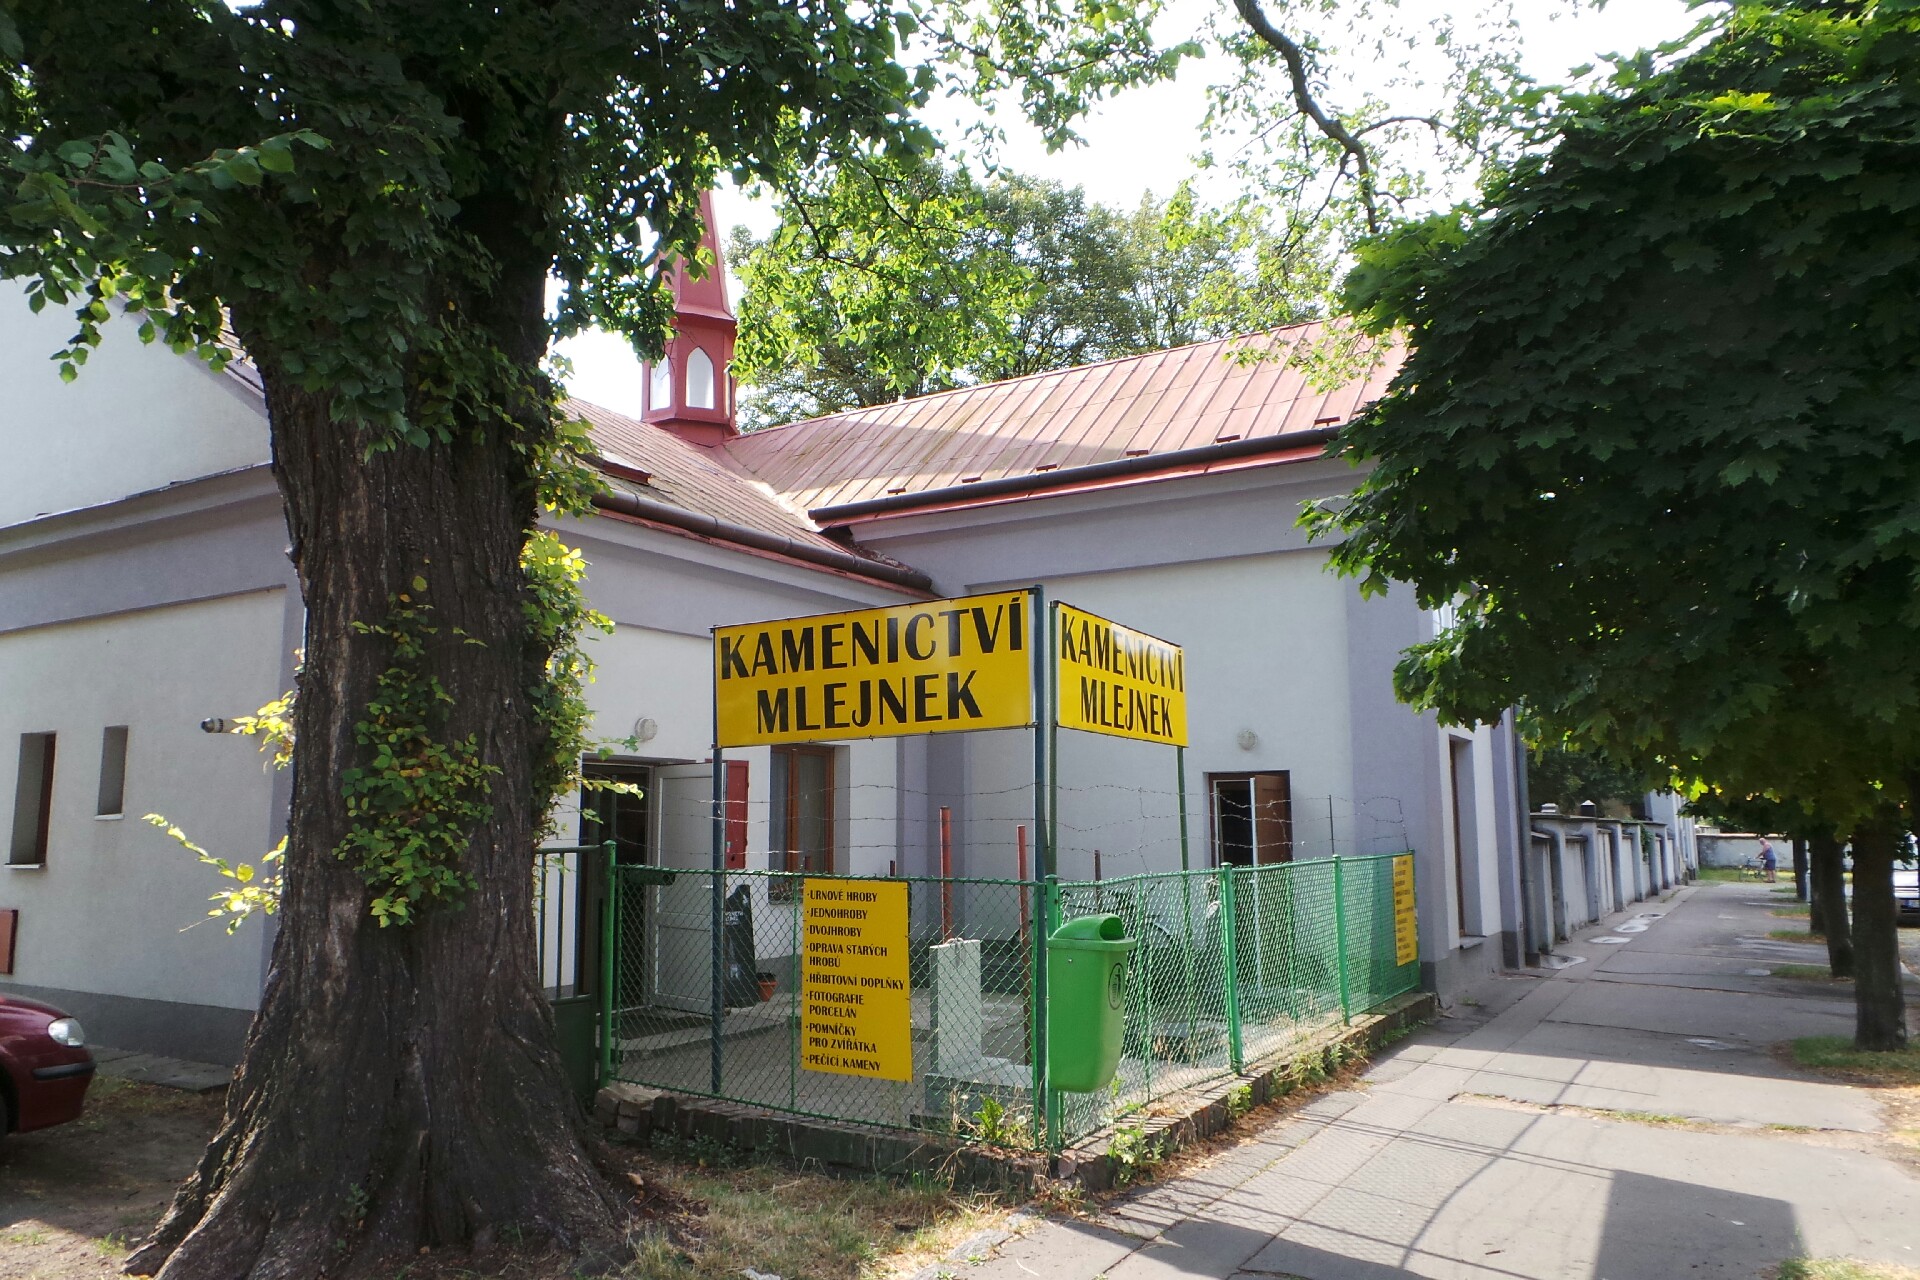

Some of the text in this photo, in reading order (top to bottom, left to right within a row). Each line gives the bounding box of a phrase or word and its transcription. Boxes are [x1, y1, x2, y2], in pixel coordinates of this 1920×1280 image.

[720, 597, 1022, 680] KAMENICTVÍ
[1061, 612, 1184, 693] KAMENICTVÍ
[757, 670, 983, 735] MLEJNEK
[1081, 675, 1173, 738] MLEJNEK
[810, 889, 878, 903] URNOVÉ HROBY
[810, 907, 868, 920] JEDNOHROBY
[809, 924, 862, 938] DVOJHROBY
[809, 942, 888, 957] OPRAVA STARÝCH
[809, 973, 905, 991] HŘBITOVNÍ DOPLŇKY
[809, 990, 864, 1005] FOTOGRAFIE
[809, 1004, 857, 1019] PORCELÁN
[809, 1022, 857, 1037] POMNÍČKY
[809, 1036, 877, 1054] PRO ZVÍŘÁTKA
[809, 1053, 881, 1072] PEČÍCÍ KAMENY
